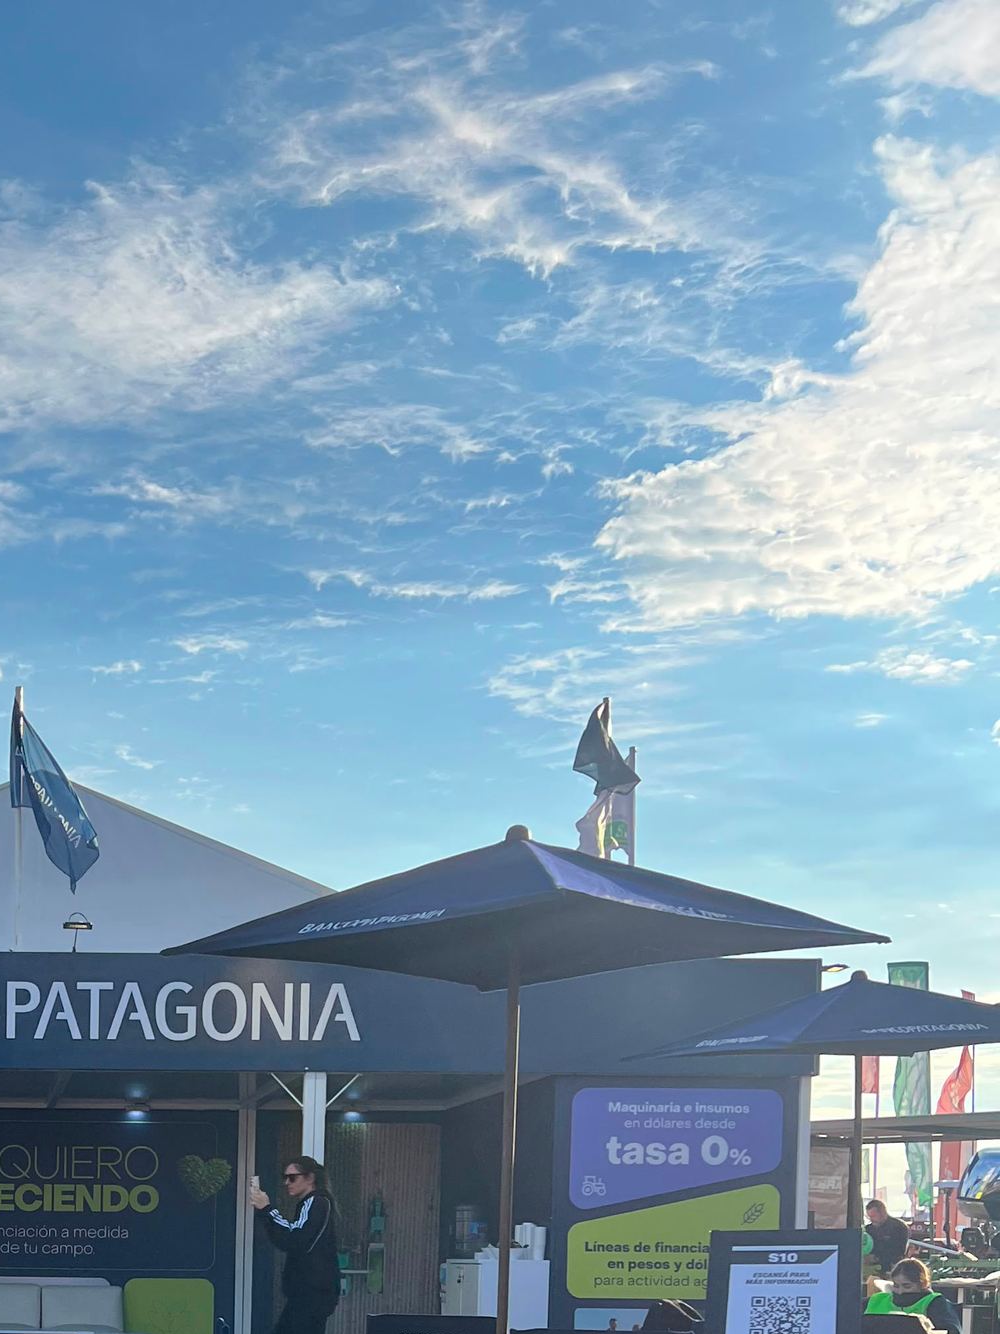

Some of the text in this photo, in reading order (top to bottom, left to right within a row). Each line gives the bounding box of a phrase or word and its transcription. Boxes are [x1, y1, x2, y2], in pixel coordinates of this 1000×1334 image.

[608, 1101, 750, 1115] Maquinaria e insumos
[624, 1117, 736, 1129] en dólares desde
[606, 1135, 752, 1166] tasa 0%
[60, 1227, 70, 1239] a
[73, 1223, 129, 1239] medida
[0, 1240, 96, 1257] de tu campo.
[584, 1240, 710, 1254] Líneas de financia
[768, 1252, 799, 1263] S10
[607, 1259, 707, 1272] en pesos y dól
[593, 1276, 626, 1289] para
[627, 1275, 689, 1287] actividad
